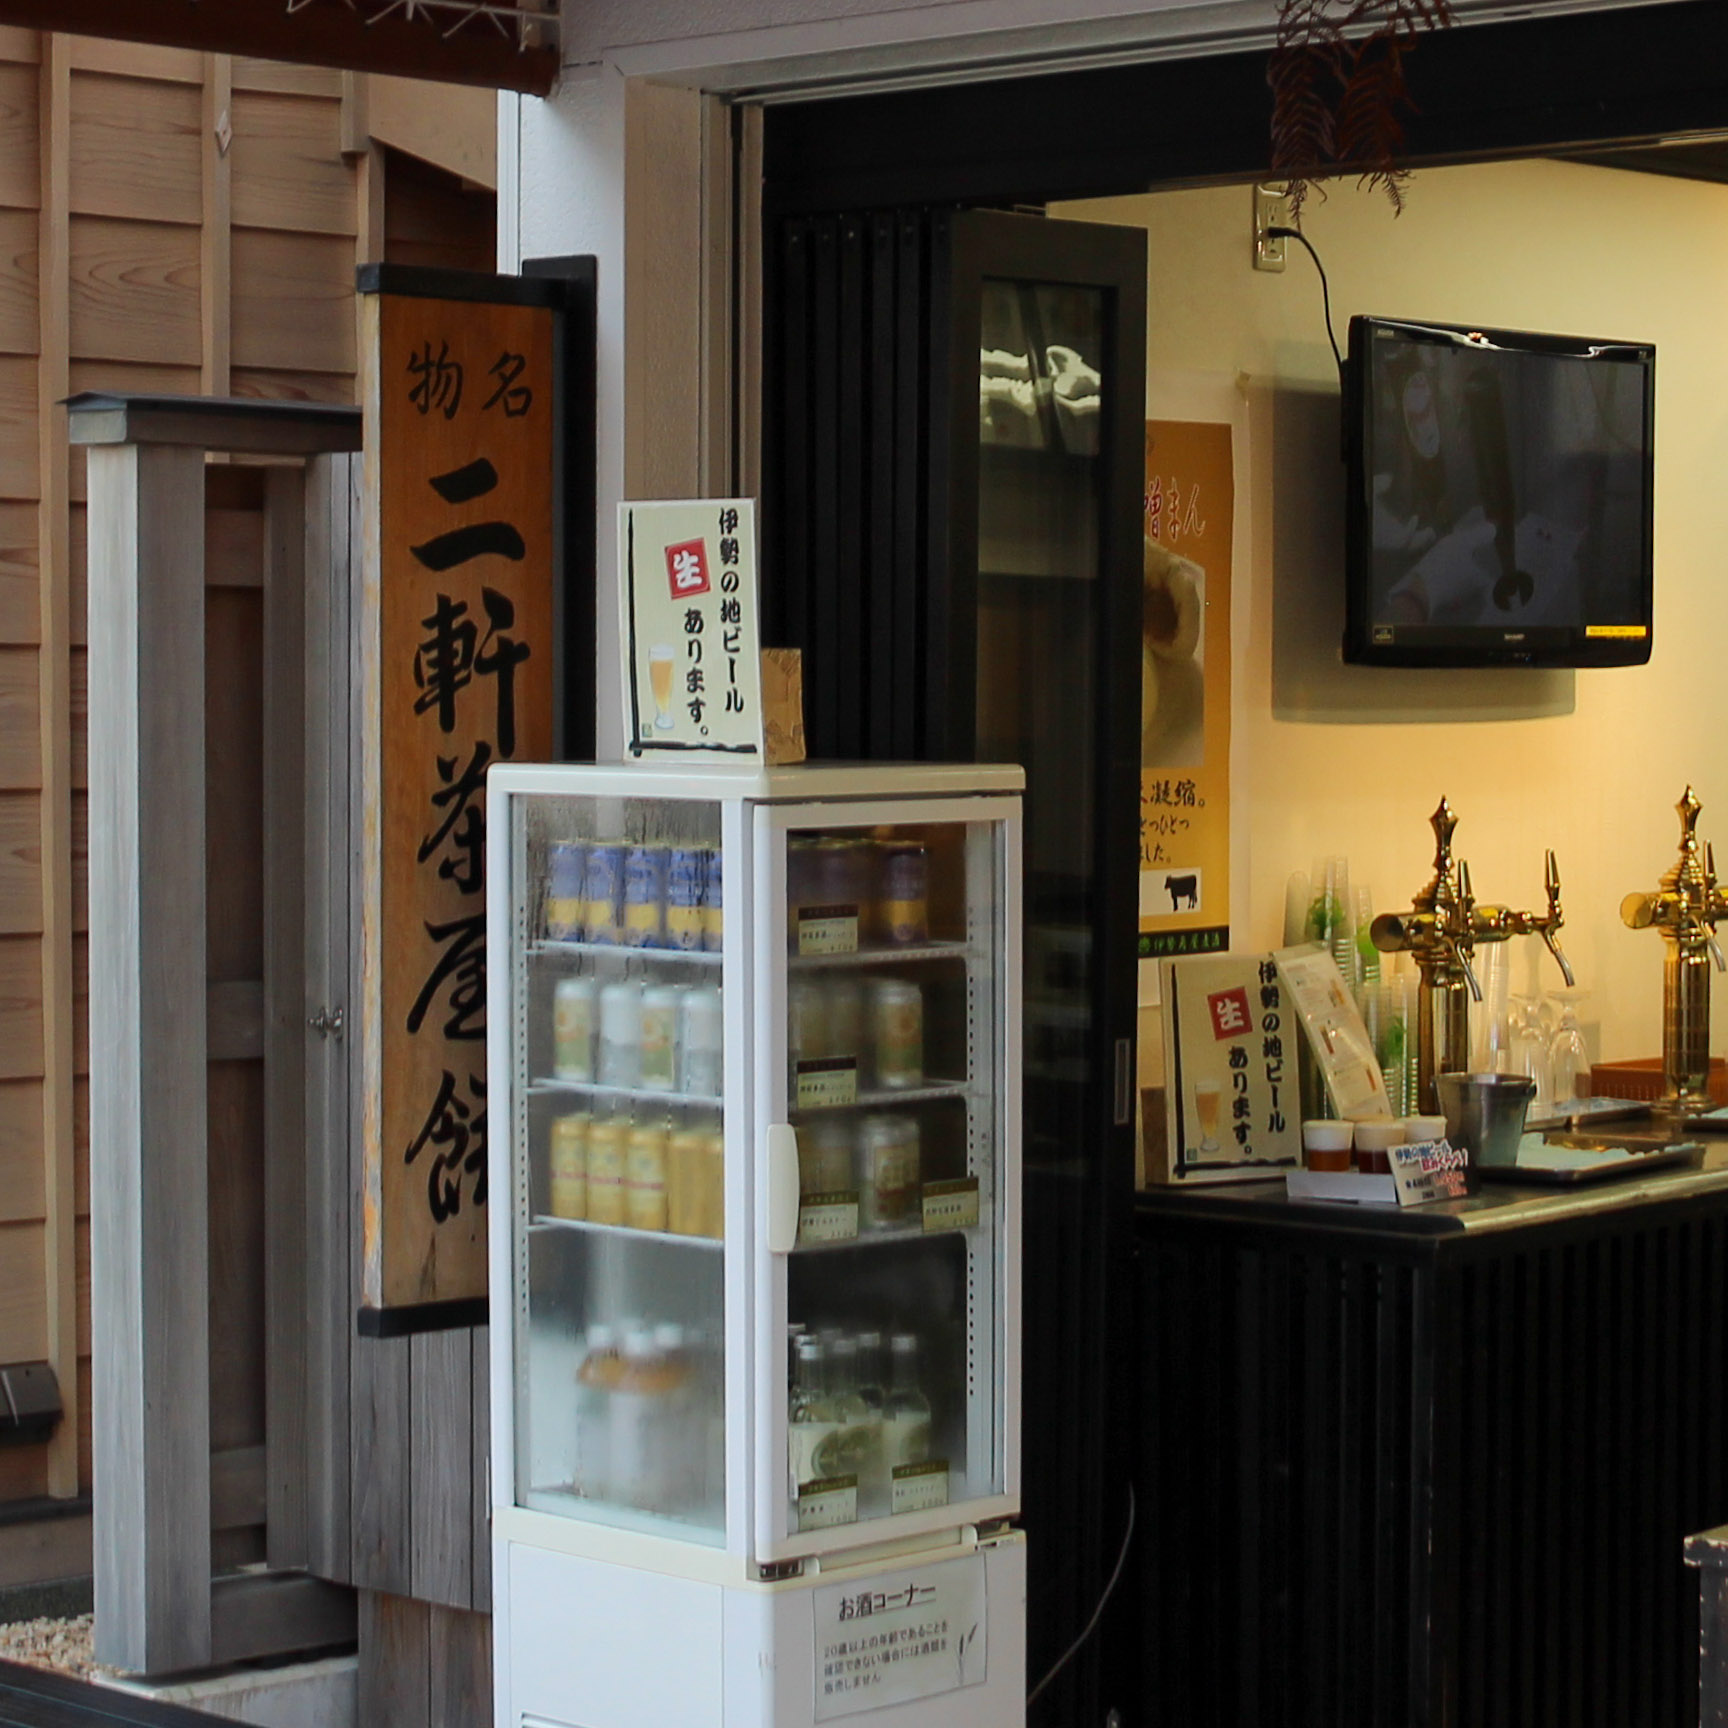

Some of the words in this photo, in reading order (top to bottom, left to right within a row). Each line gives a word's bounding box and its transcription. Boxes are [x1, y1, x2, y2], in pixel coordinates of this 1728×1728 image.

[673, 550, 703, 589] 生
[719, 508, 744, 714] 伊勢の地ビール
[683, 609, 709, 736] あります。
[839, 1583, 937, 1622] お酒コーナー
